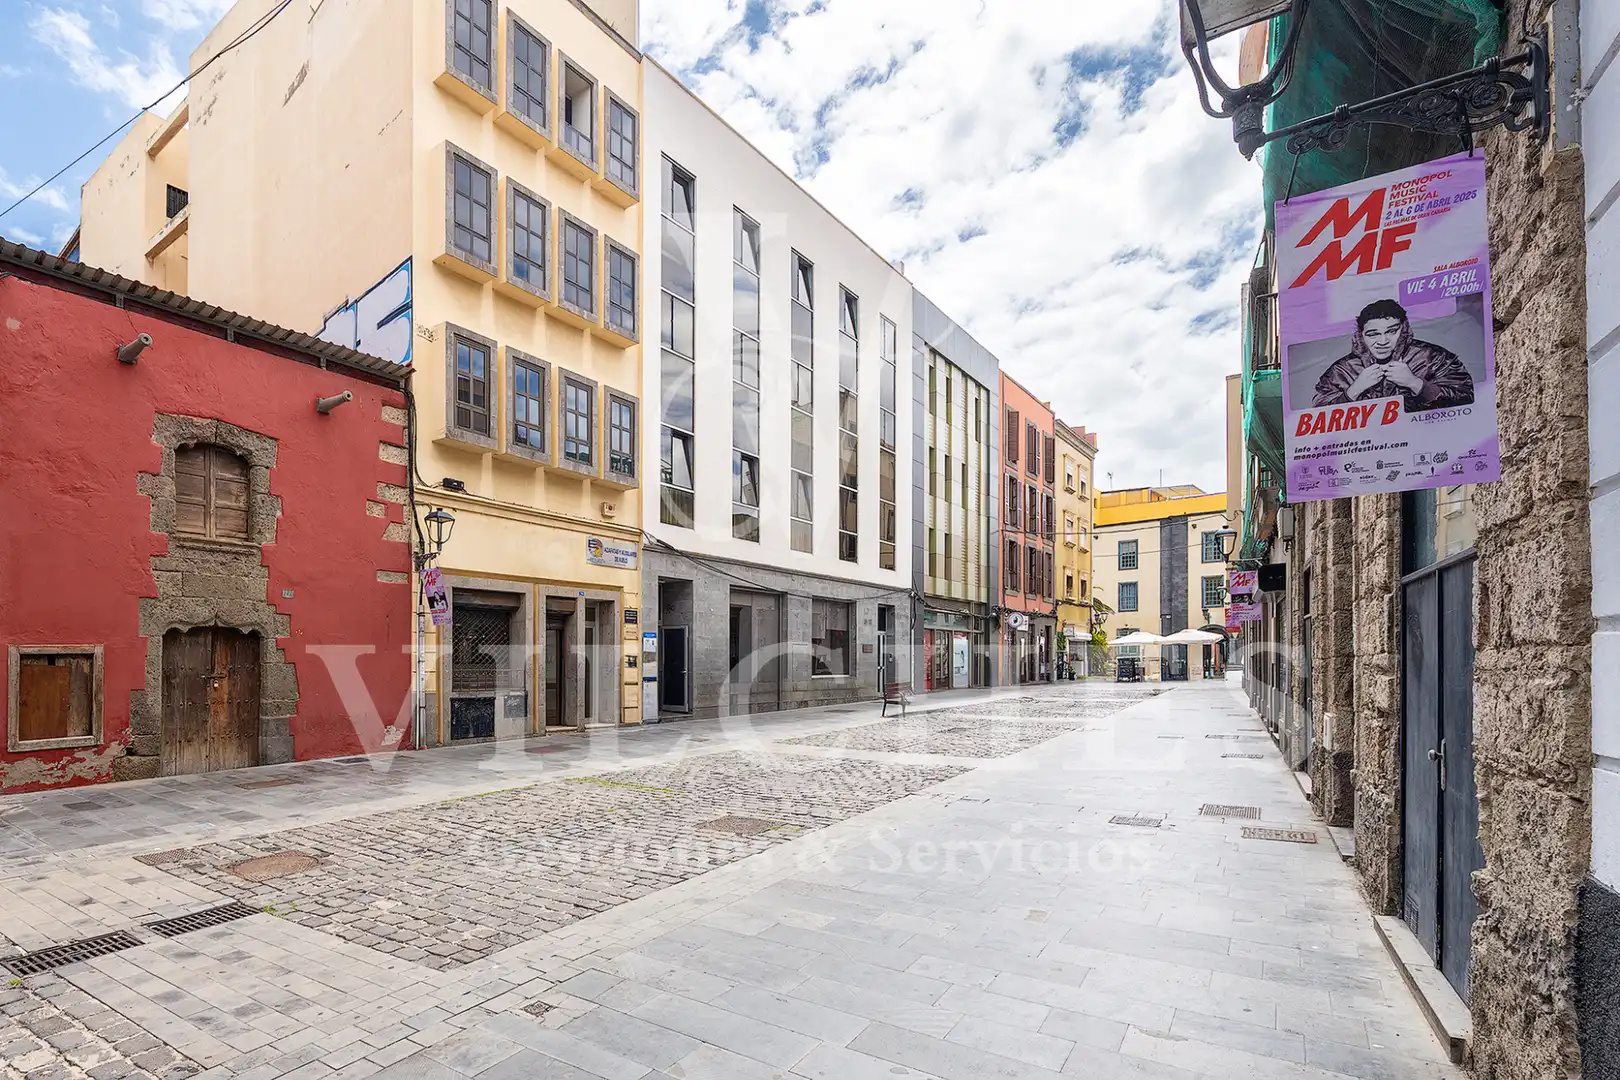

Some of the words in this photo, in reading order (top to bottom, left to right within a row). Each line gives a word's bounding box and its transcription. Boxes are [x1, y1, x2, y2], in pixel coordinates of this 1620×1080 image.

[1391, 170, 1452, 192] MONOPOL
[1388, 191, 1439, 209] FESTIVAL
[1390, 185, 1427, 200] MUSIC
[1385, 210, 1392, 220] 2
[1393, 207, 1404, 218] AL
[1406, 206, 1412, 215] 6
[1414, 203, 1425, 213] DE
[1426, 196, 1451, 210] ABRIL
[1453, 189, 1477, 204] 2025
[1288, 222, 1417, 289] MF
[1407, 279, 1425, 294] VIE
[1428, 277, 1436, 290] 4
[1439, 269, 1477, 289] ABRIL
[1295, 403, 1378, 437] BARRY
[1381, 400, 1400, 426] B
[1293, 441, 1409, 460] monopolmusicfestival.com
[1294, 446, 1311, 454] info
[1322, 440, 1358, 450] entradas
